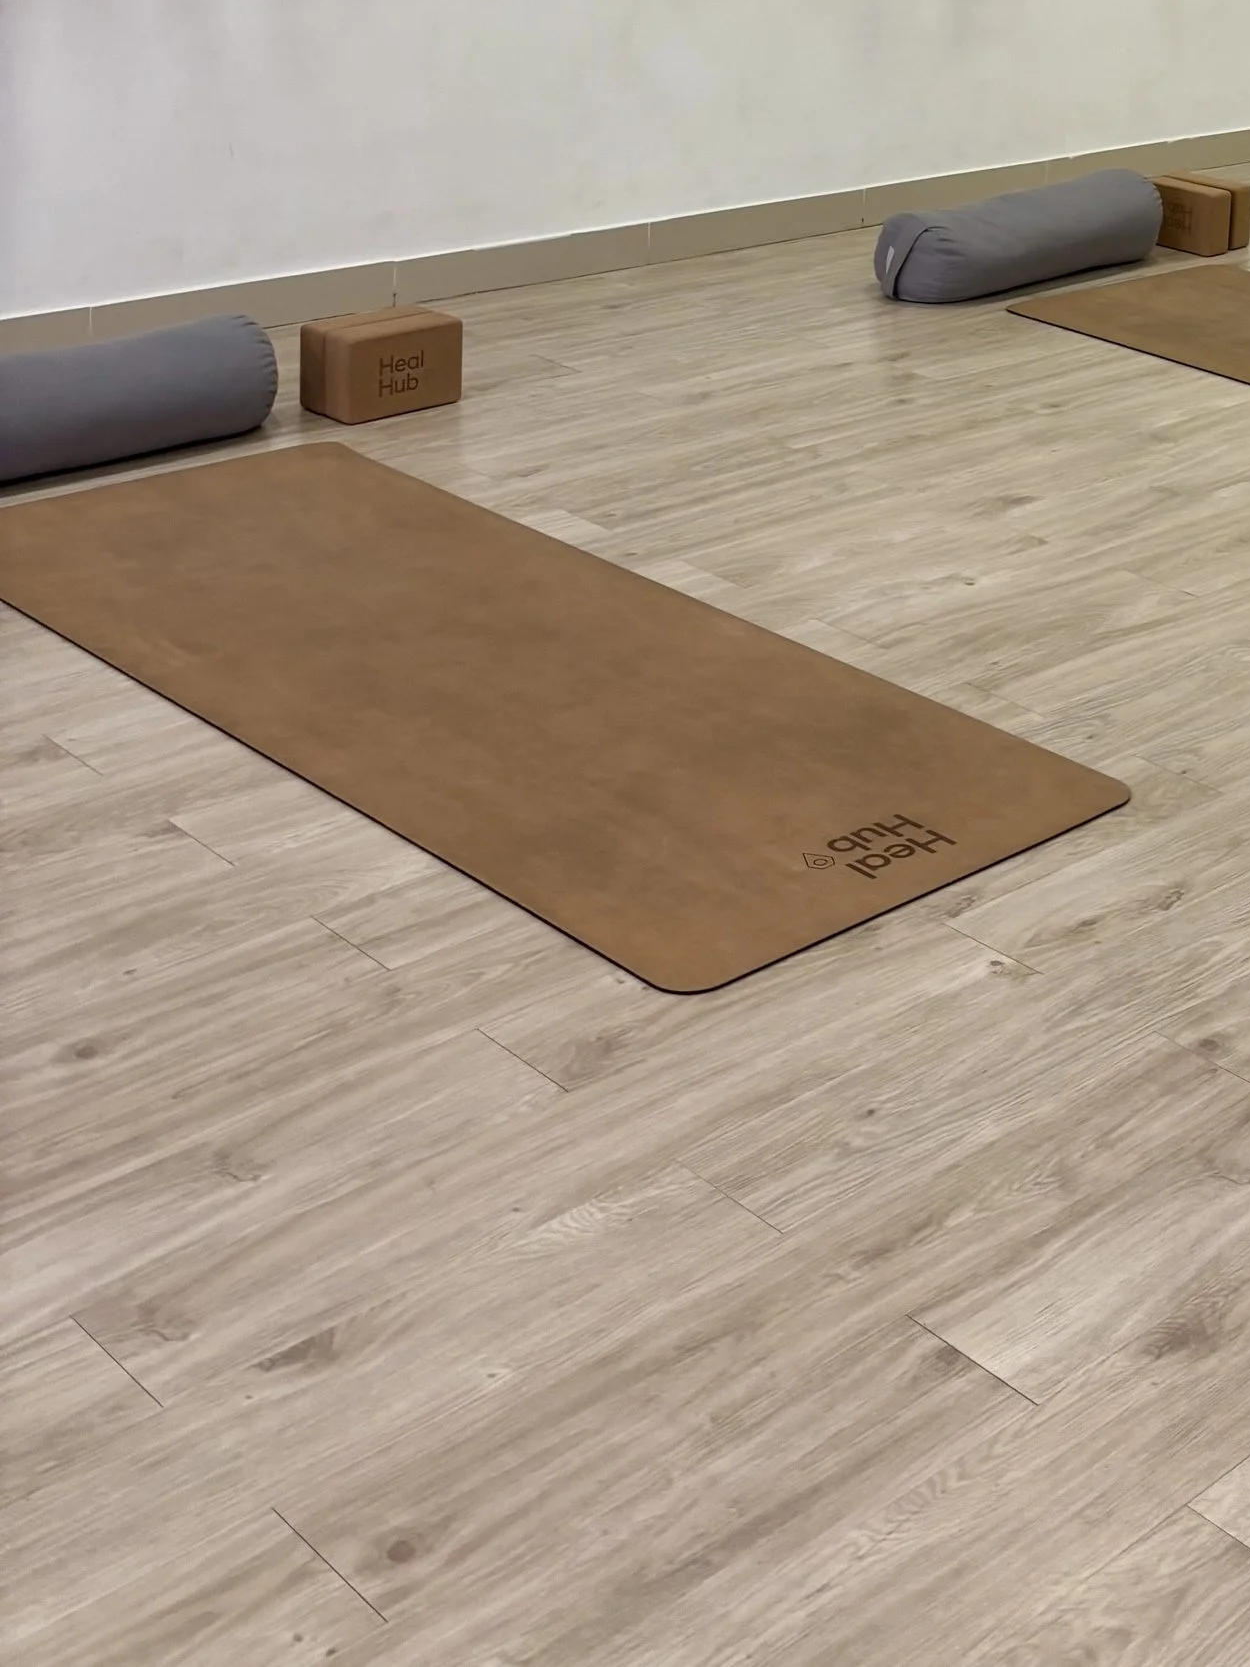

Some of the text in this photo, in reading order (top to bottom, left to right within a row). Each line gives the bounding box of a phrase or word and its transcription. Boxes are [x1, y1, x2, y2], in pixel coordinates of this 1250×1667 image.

[378, 349, 425, 376] Heal
[378, 373, 420, 398] Hub
[826, 813, 925, 853] Hub
[844, 829, 958, 880] Heal
